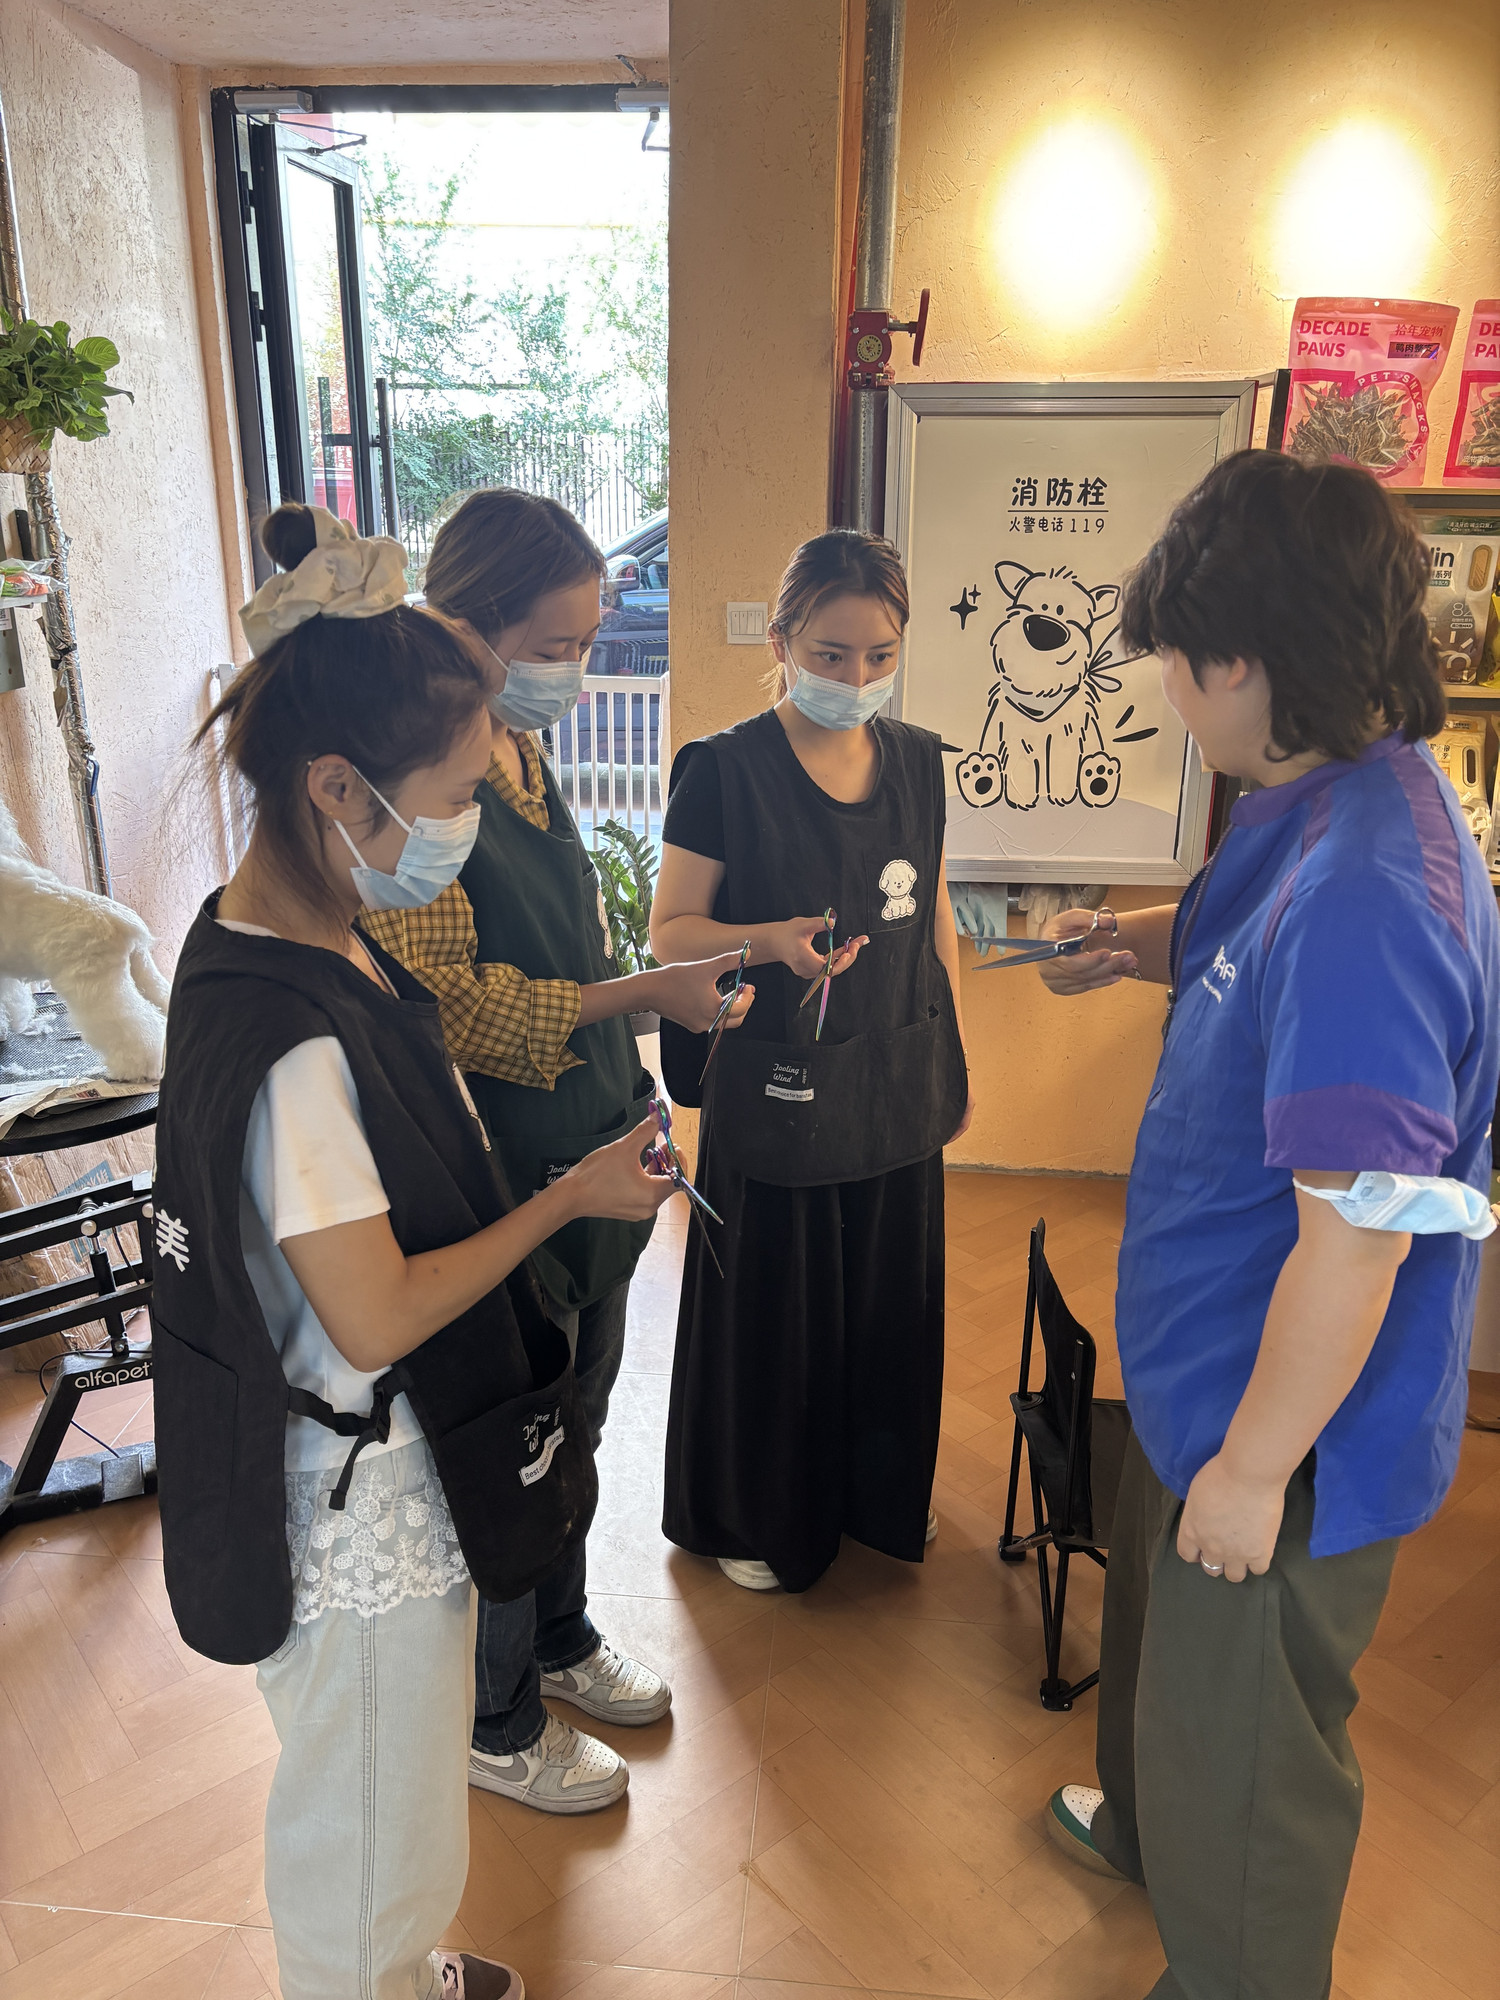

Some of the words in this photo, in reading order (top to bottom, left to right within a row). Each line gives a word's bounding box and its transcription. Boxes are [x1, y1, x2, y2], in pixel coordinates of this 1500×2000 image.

[1299, 320, 1371, 336] DECADE
[1395, 324, 1443, 337] 拾年宠物
[1297, 341, 1346, 358] PAWS
[1358, 372, 1391, 386] PET
[1402, 374, 1428, 432] SNACKS
[1011, 477, 1107, 506] 消防栓
[773, 1073, 793, 1083] Wind
[75, 1362, 149, 1388] alfapet
